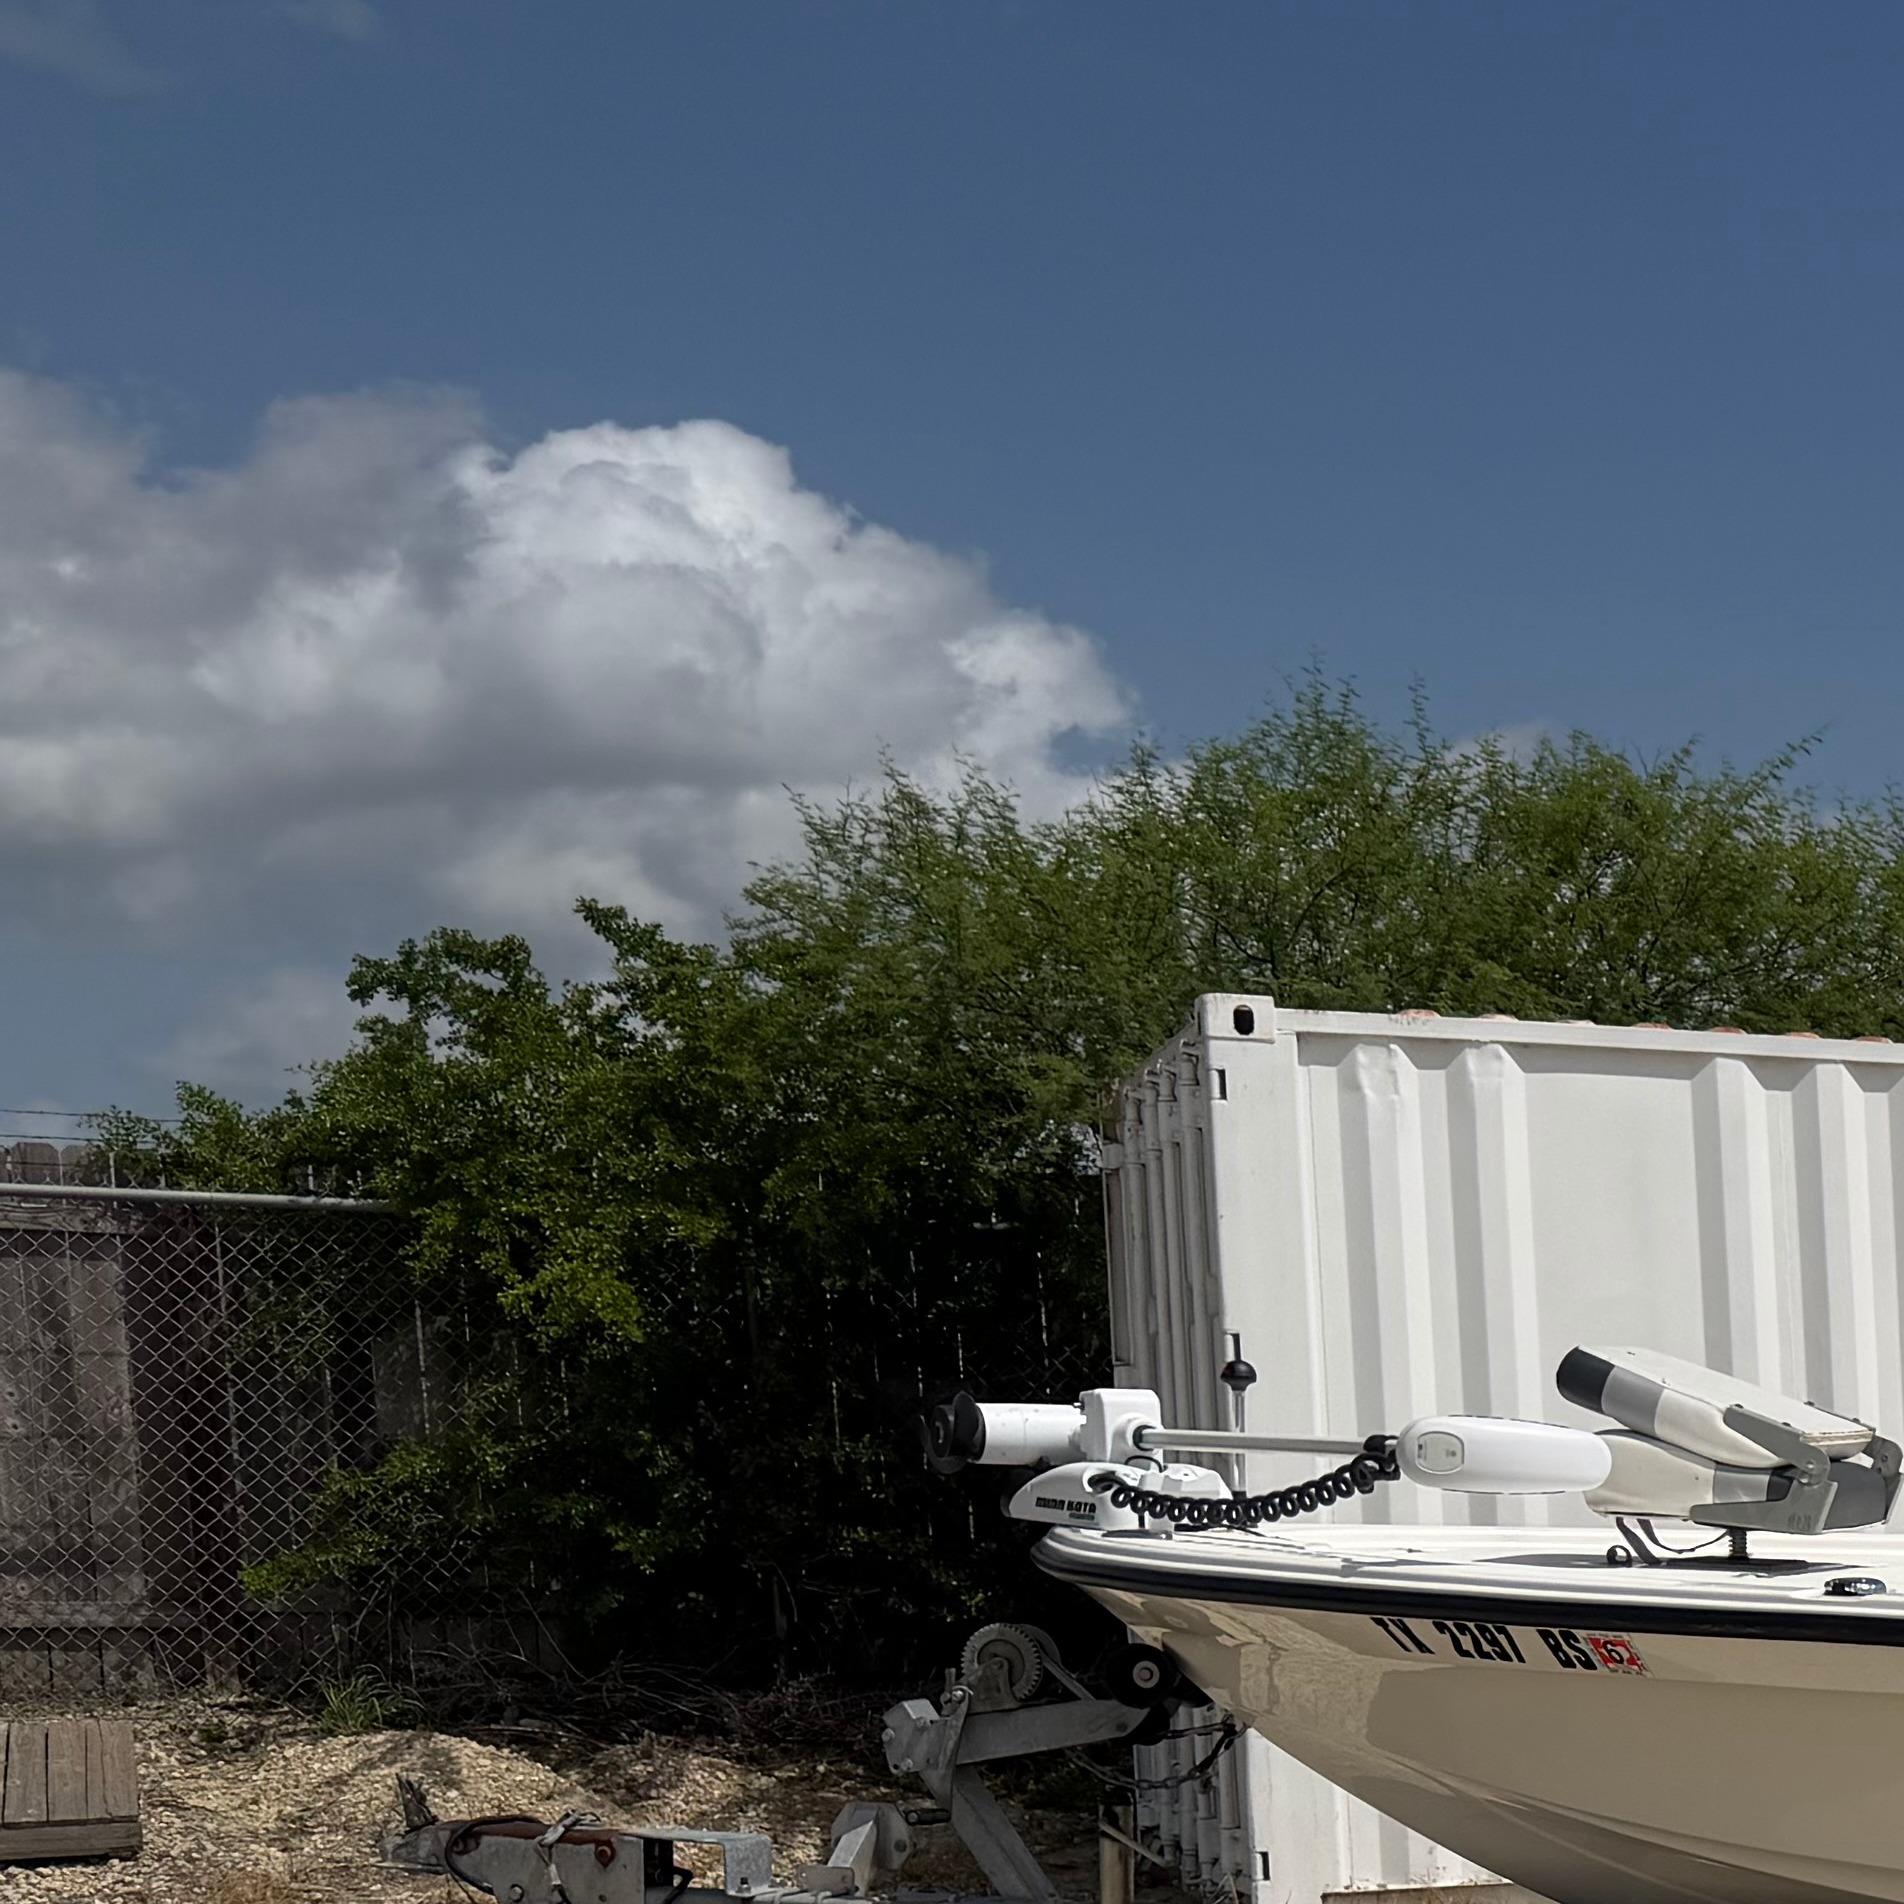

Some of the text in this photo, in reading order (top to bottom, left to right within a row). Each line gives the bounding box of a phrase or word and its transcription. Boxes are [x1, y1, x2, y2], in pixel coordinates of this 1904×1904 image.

[1369, 1616, 1598, 1671] TX 2297 BS
